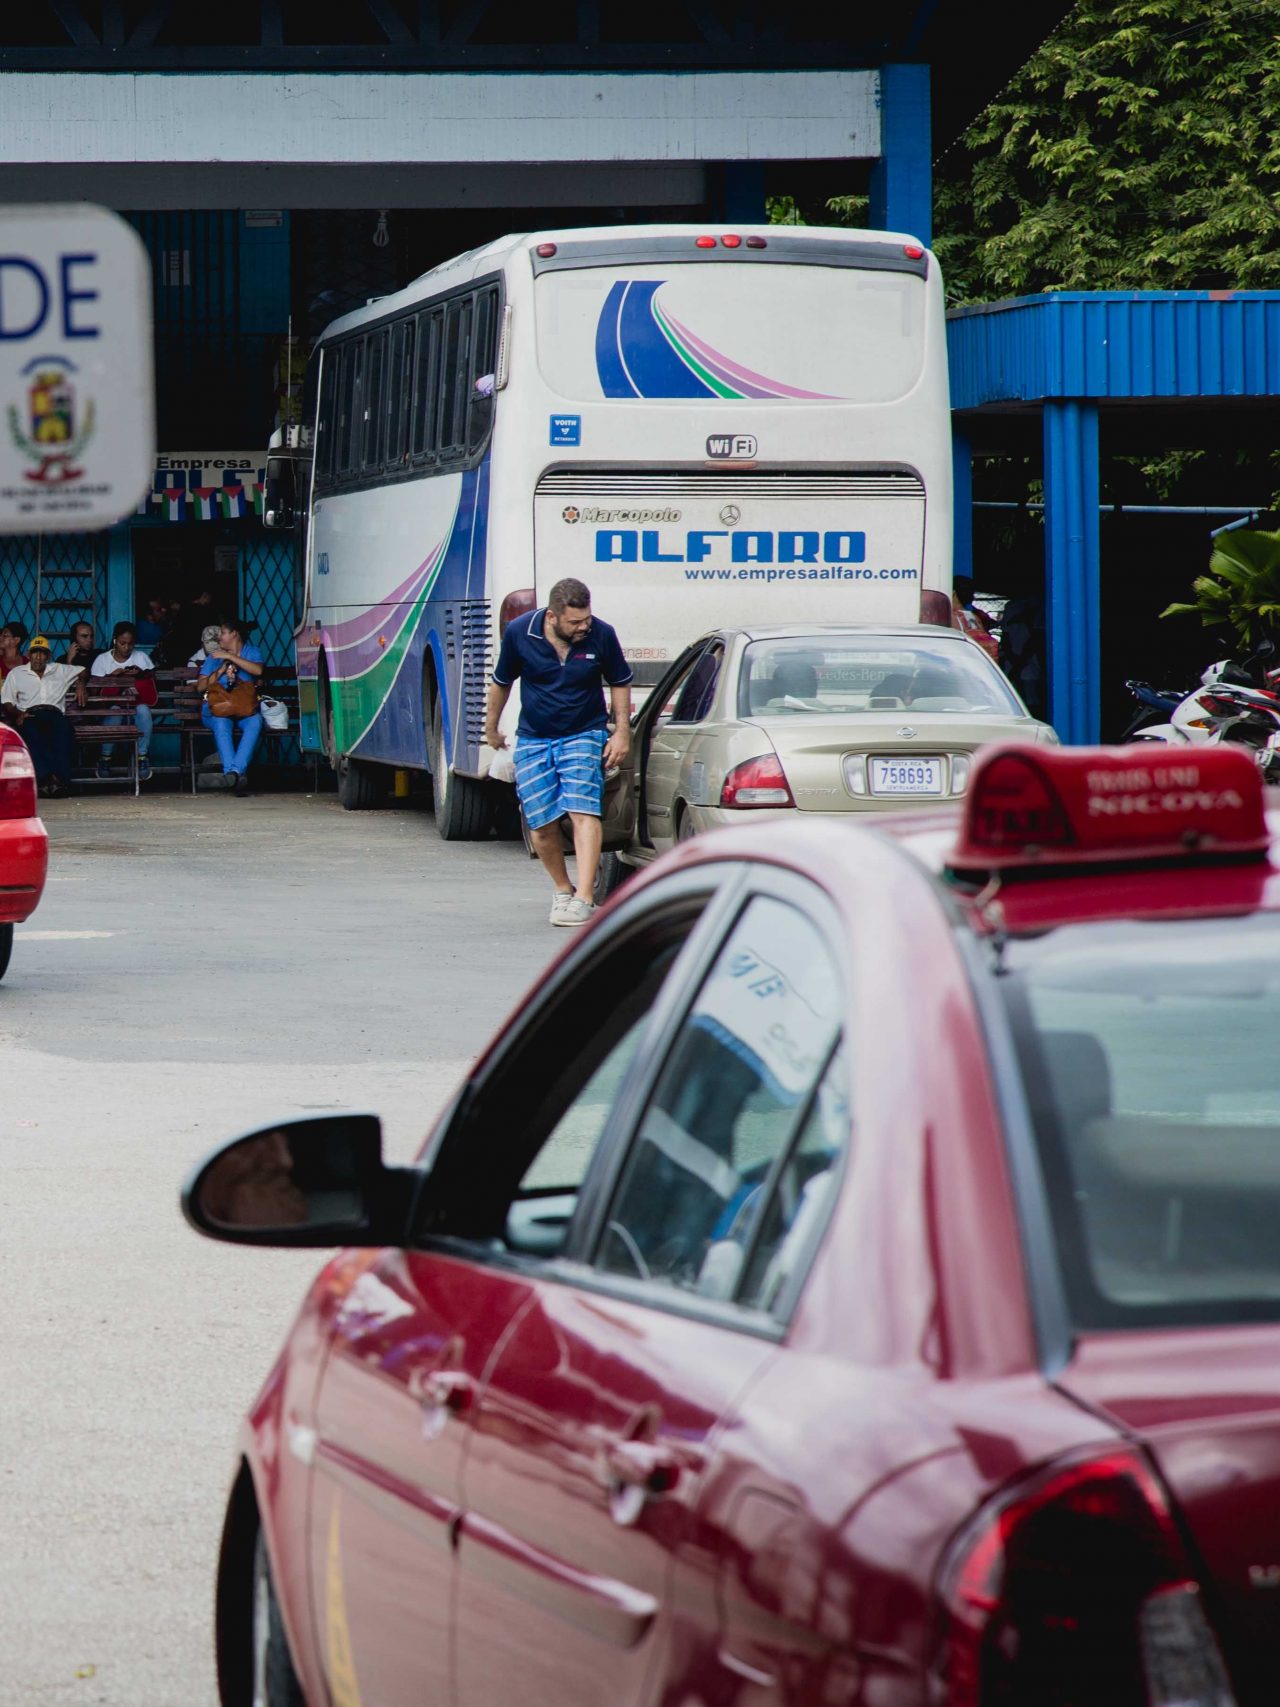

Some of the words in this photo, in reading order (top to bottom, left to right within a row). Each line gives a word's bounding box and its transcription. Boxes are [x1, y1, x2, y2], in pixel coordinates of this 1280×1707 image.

[157, 456, 252, 469] Empresa
[581, 506, 682, 524] Marcopolo
[595, 530, 866, 563] ALFARO
[685, 566, 918, 583] www.empresaalfaro.com
[881, 767, 933, 785] 758693
